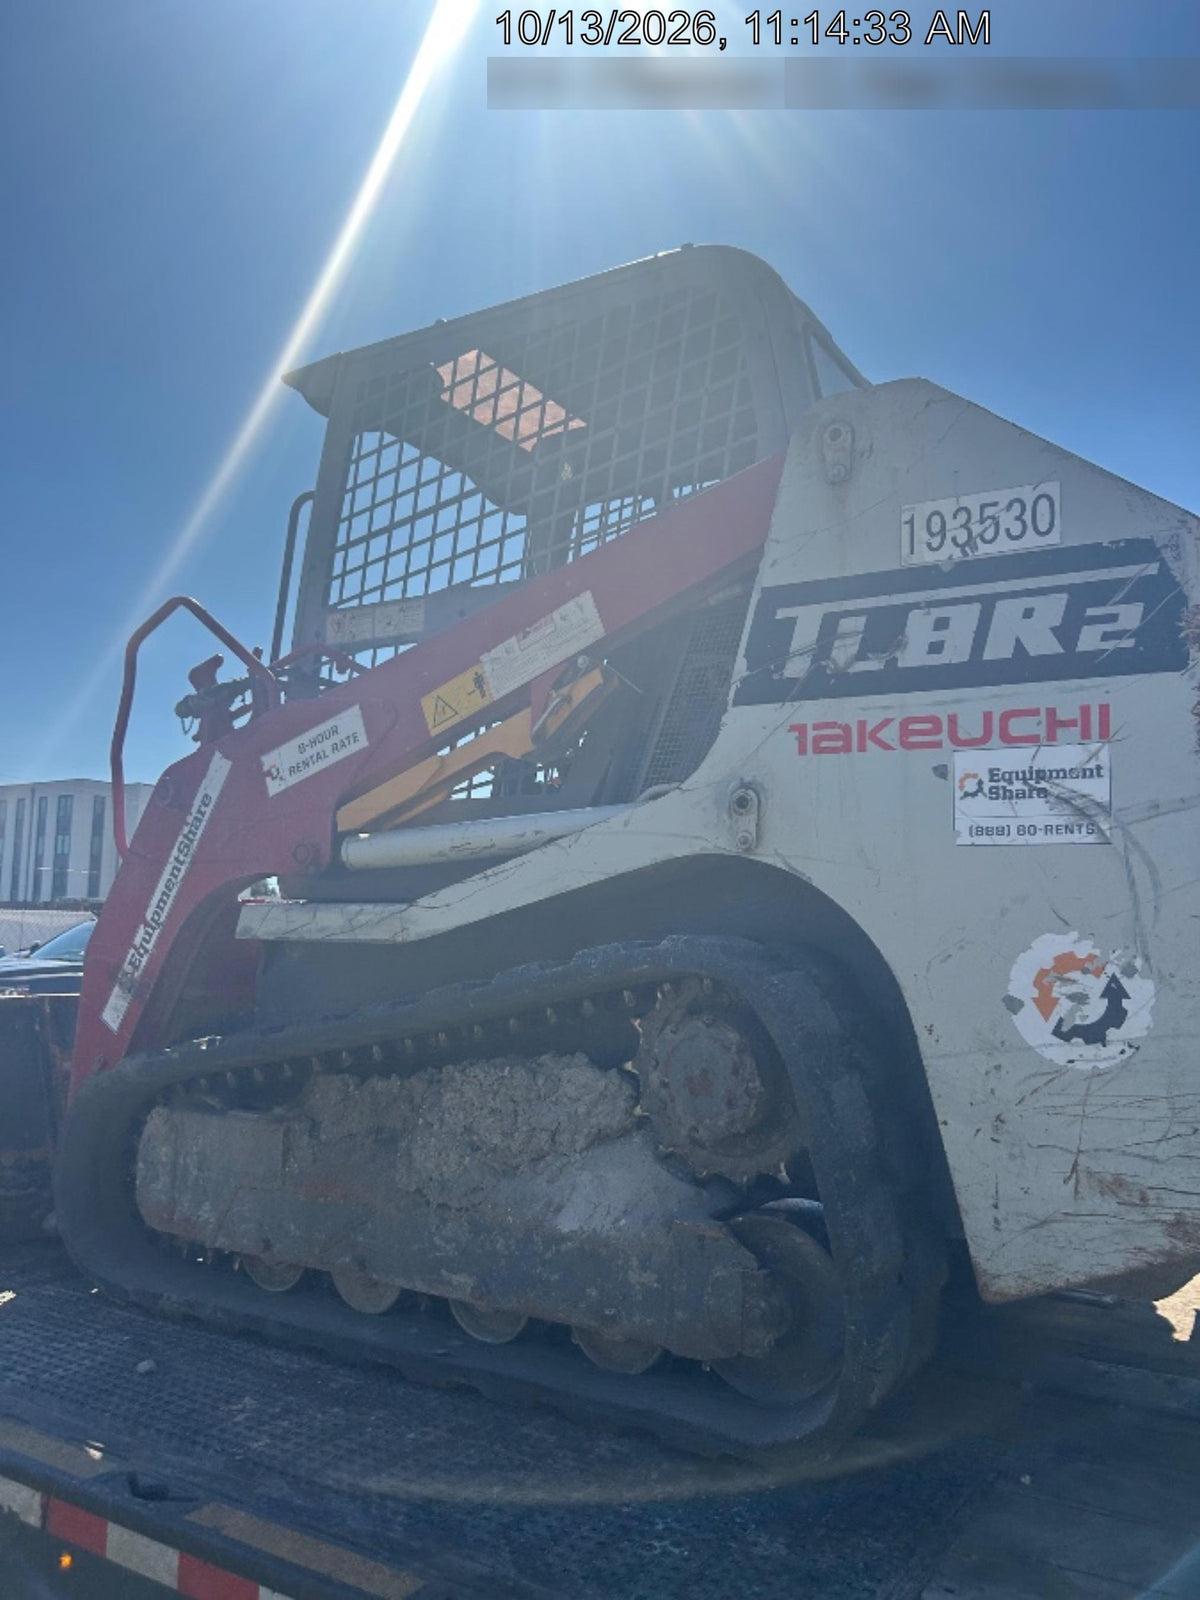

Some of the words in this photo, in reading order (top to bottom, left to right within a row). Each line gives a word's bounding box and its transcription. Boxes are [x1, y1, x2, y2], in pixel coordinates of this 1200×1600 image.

[903, 493, 1055, 555] 193530
[288, 749, 329, 776] RENTAL
[331, 732, 360, 754] RATE
[298, 725, 339, 754] 8-HOUR
[988, 764, 1104, 785] Equipment
[988, 785, 1049, 801] Share
[968, 824, 1011, 838] (888)
[127, 793, 212, 973] EquipmentShare
